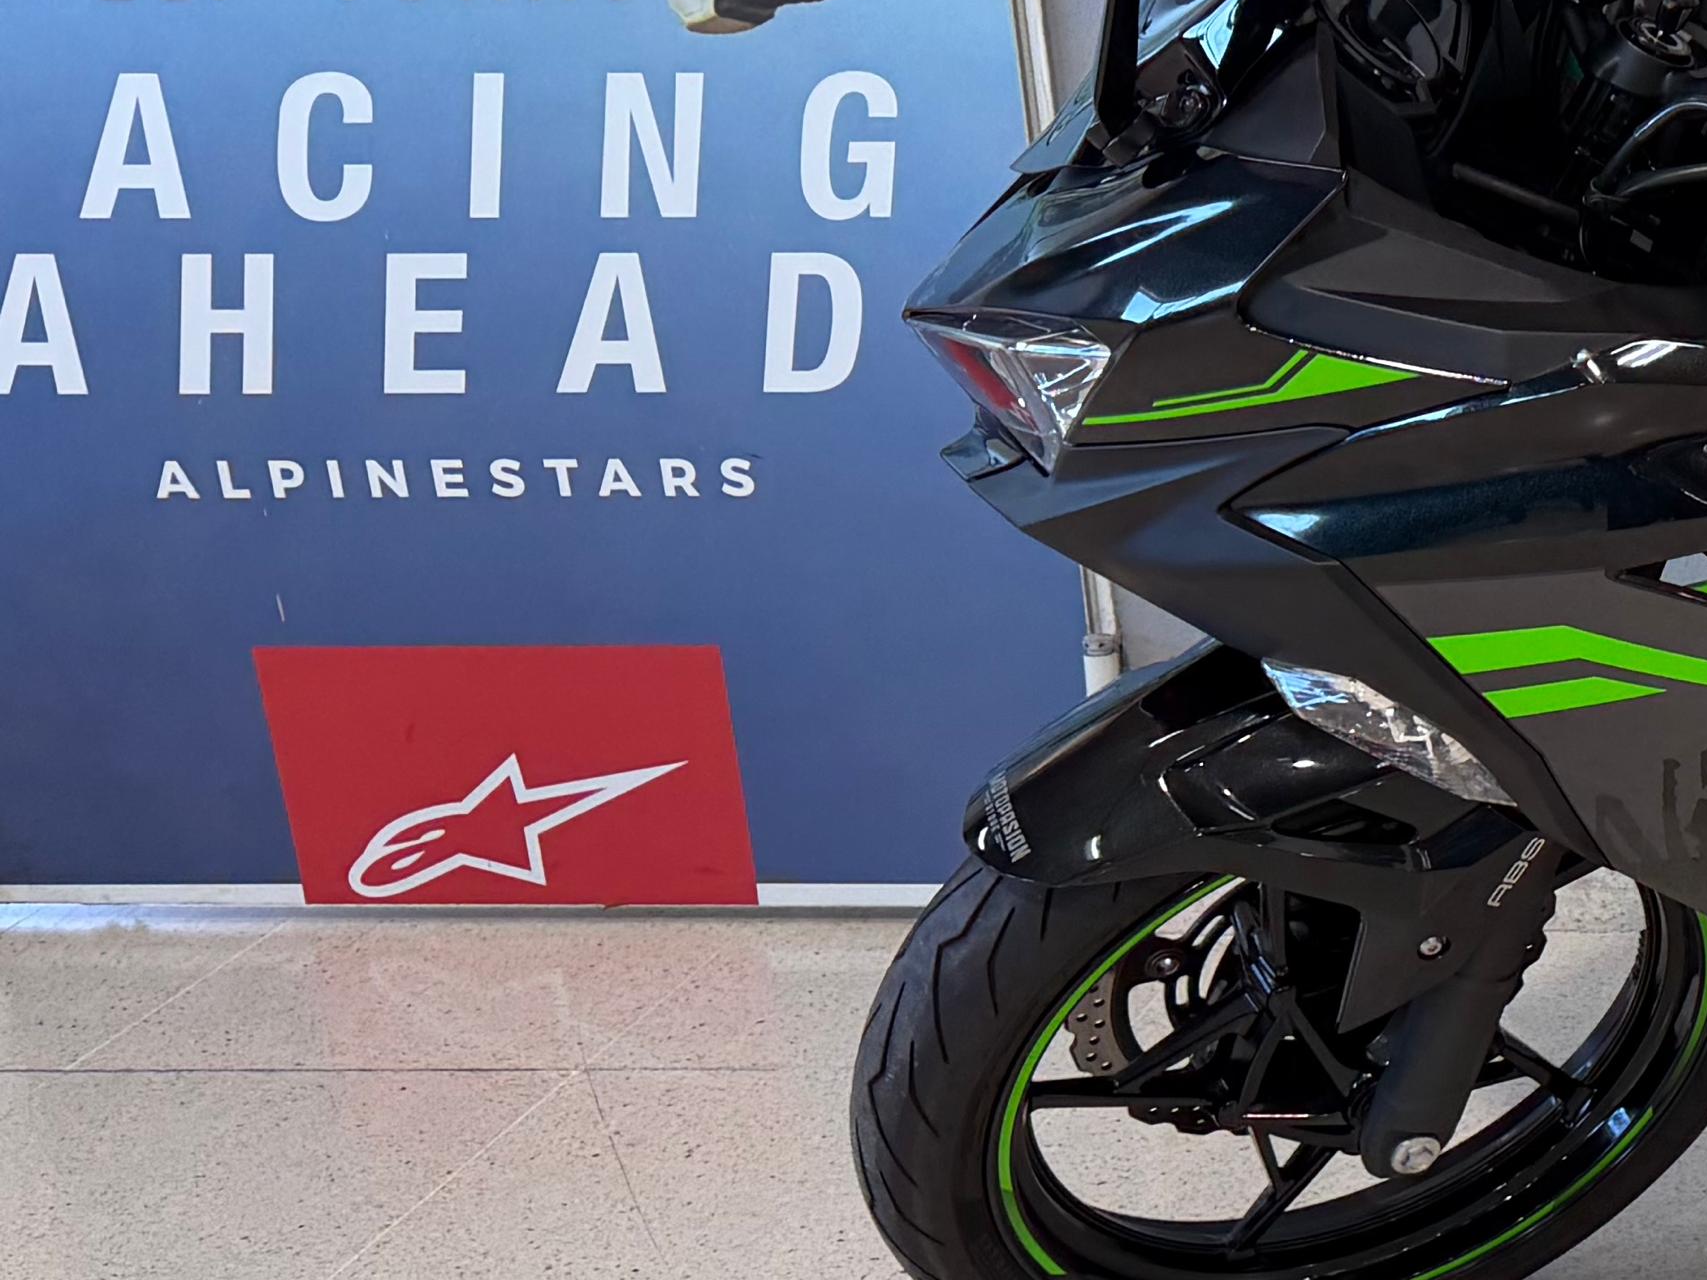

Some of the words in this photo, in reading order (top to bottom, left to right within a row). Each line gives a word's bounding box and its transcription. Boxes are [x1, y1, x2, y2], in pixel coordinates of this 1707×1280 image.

[80, 69, 899, 223] ACING
[0, 251, 863, 396] AHEAD
[156, 457, 756, 499] ALPINESTARS
[990, 769, 1032, 863] MOTOPASION
[1487, 837, 1545, 907] ABS
